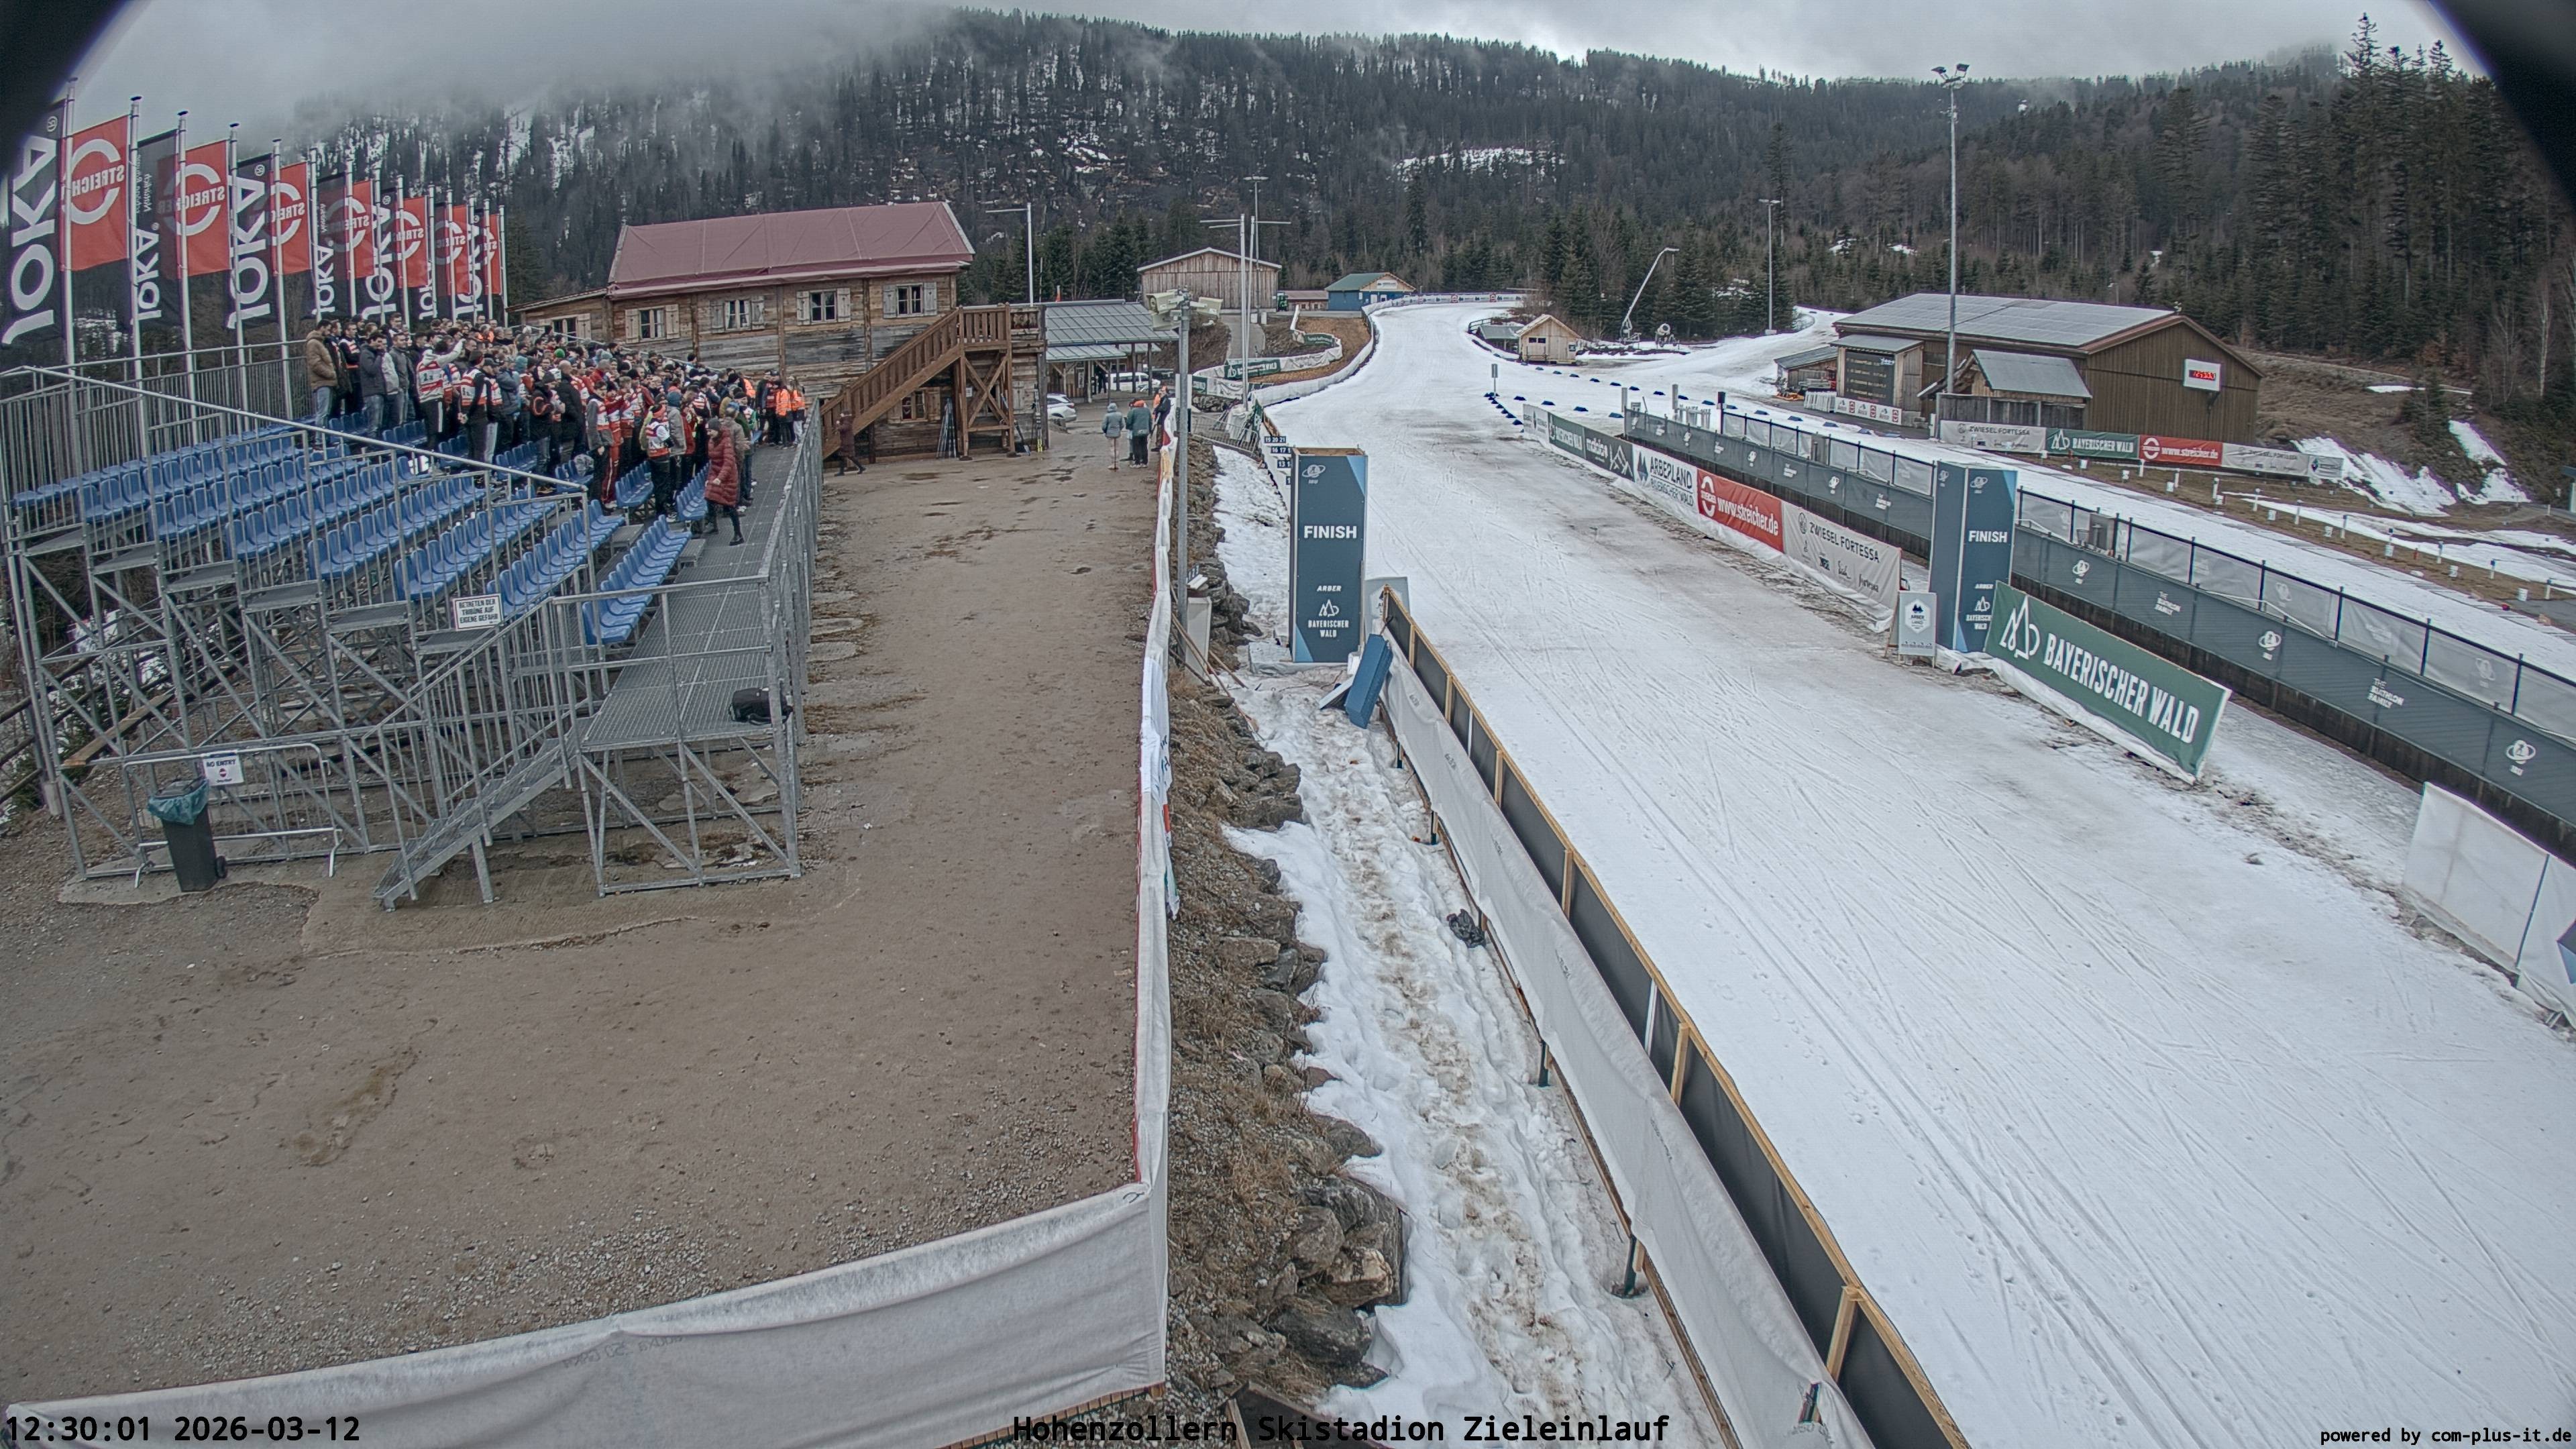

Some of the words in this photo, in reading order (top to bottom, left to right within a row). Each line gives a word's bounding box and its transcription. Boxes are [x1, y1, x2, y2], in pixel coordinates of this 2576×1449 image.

[1303, 525, 1357, 539] FINISH
[1717, 497, 1778, 536] www.streicher.de
[1809, 521, 1839, 546] ZWIESEL
[1840, 536, 1880, 564] FORTESSA
[1968, 530, 2008, 543] FINISH
[2043, 633, 2150, 718] BAYERISCHER
[2147, 686, 2200, 744] WALD
